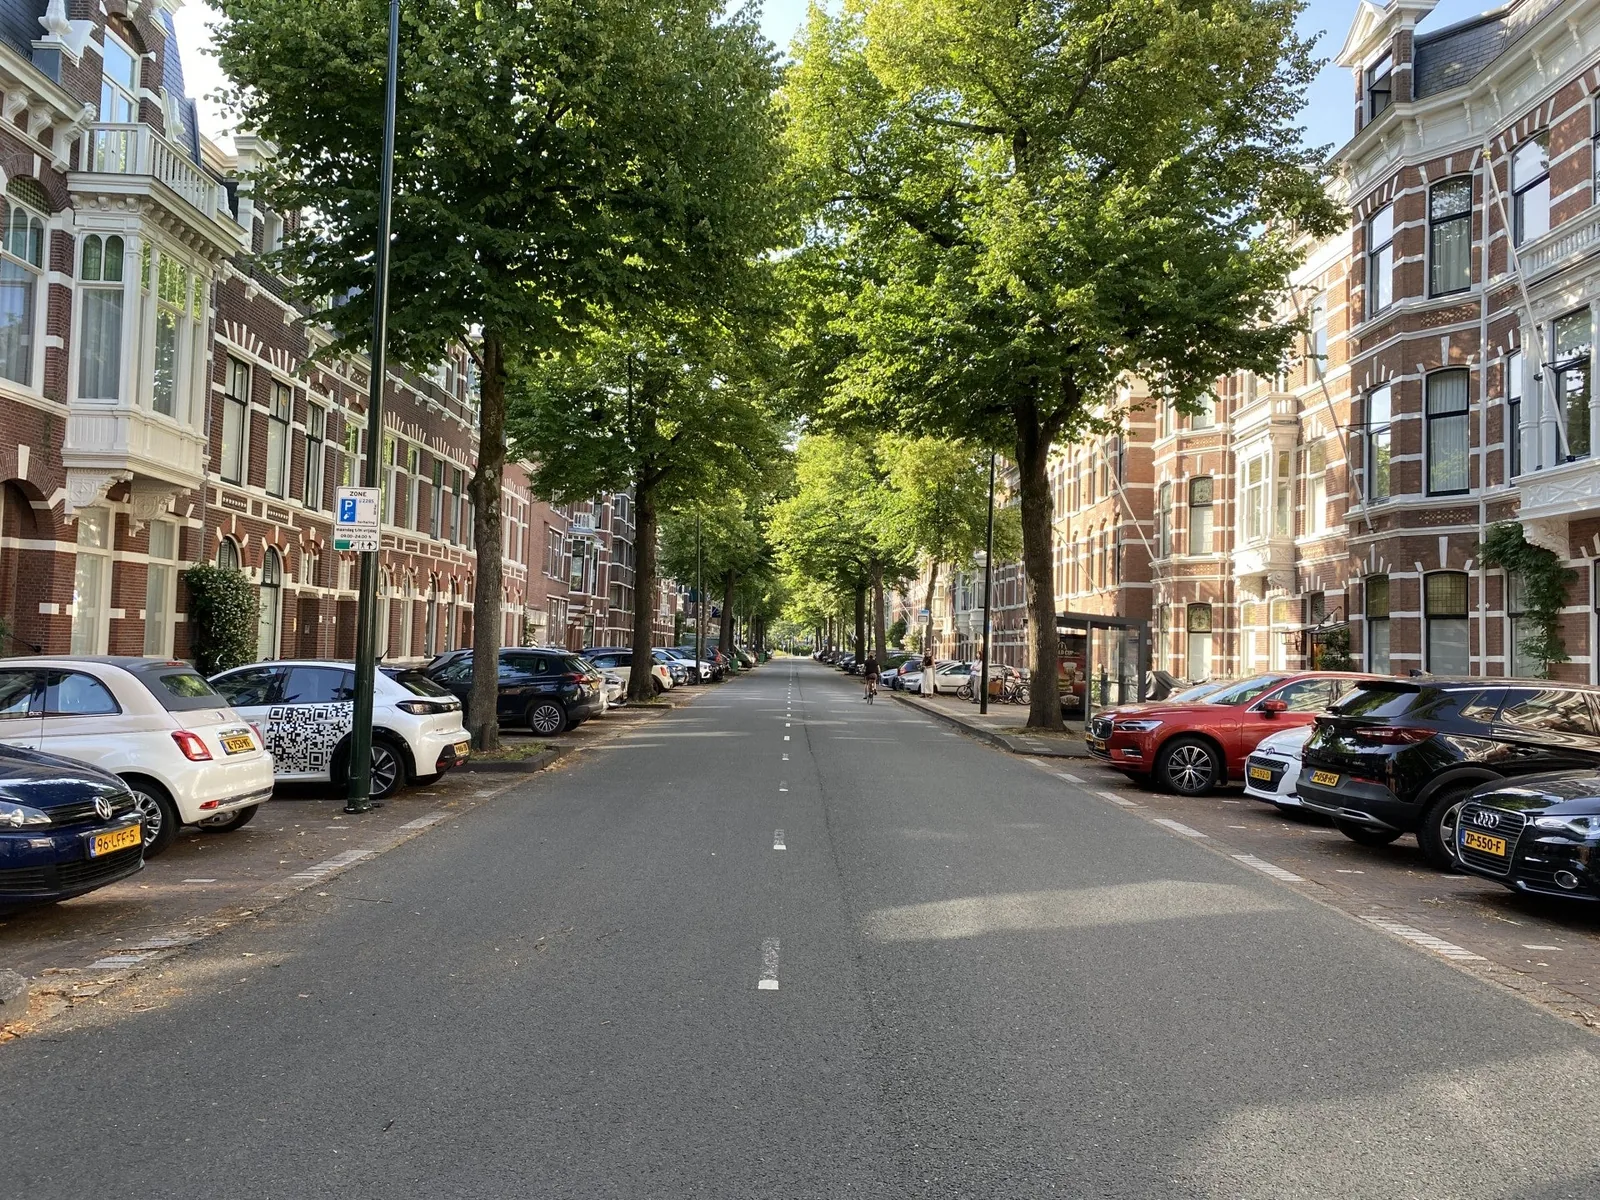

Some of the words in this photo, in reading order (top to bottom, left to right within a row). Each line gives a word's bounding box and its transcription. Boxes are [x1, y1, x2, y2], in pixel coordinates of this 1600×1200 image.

[344, 500, 354, 511] P
[97, 830, 135, 852] 96-LFF-5
[1466, 832, 1502, 852] ZP-550-F
